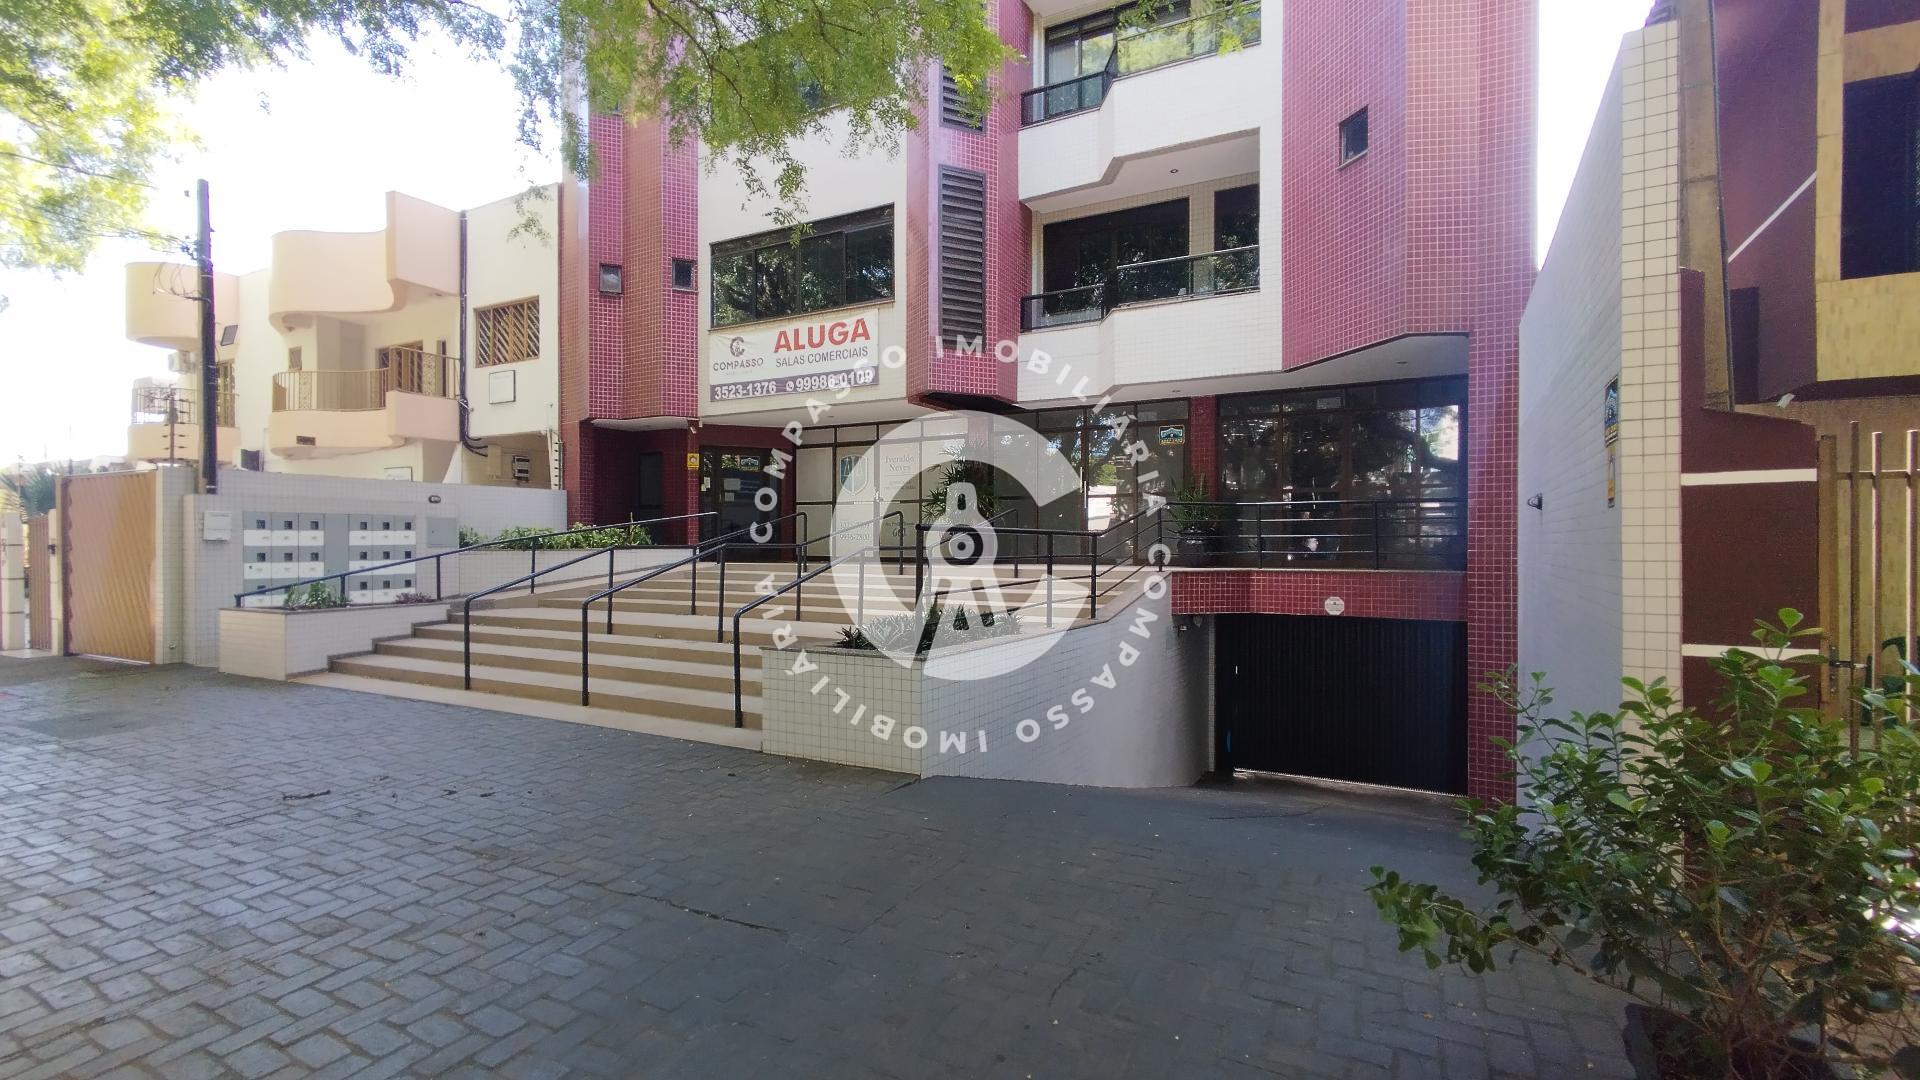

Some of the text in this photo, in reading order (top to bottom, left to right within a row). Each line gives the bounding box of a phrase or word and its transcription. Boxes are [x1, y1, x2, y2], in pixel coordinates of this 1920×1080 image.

[773, 317, 870, 353] ALUGA
[713, 357, 764, 372] COMPASSO
[775, 346, 869, 368] SALAS COMERCIAIS
[714, 381, 777, 400] 3523-1376
